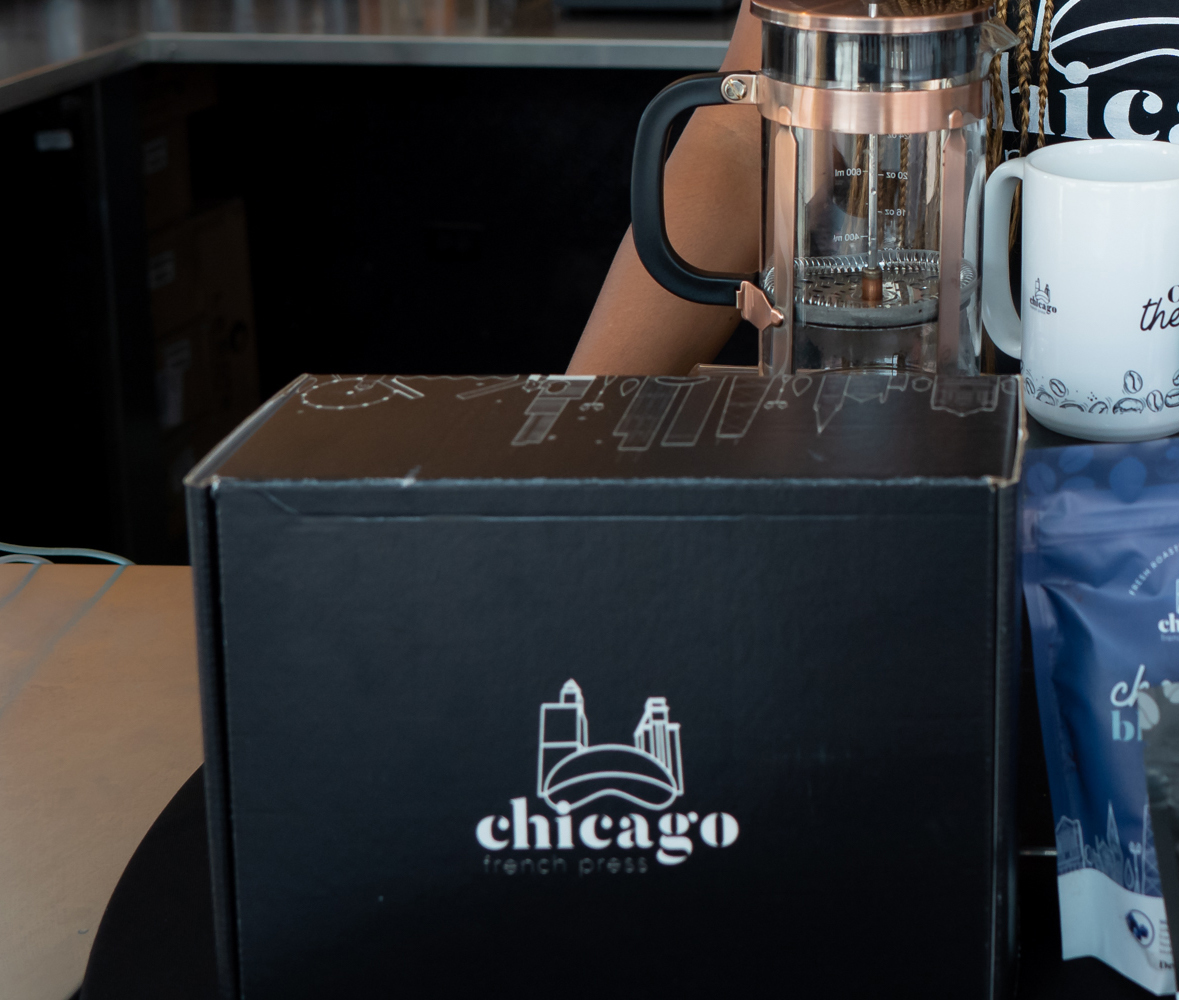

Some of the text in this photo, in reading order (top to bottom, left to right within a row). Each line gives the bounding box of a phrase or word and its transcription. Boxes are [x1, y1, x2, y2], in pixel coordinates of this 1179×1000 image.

[1128, 568, 1151, 596] FRESH
[475, 797, 740, 866] chicago
[483, 855, 649, 877] french press
